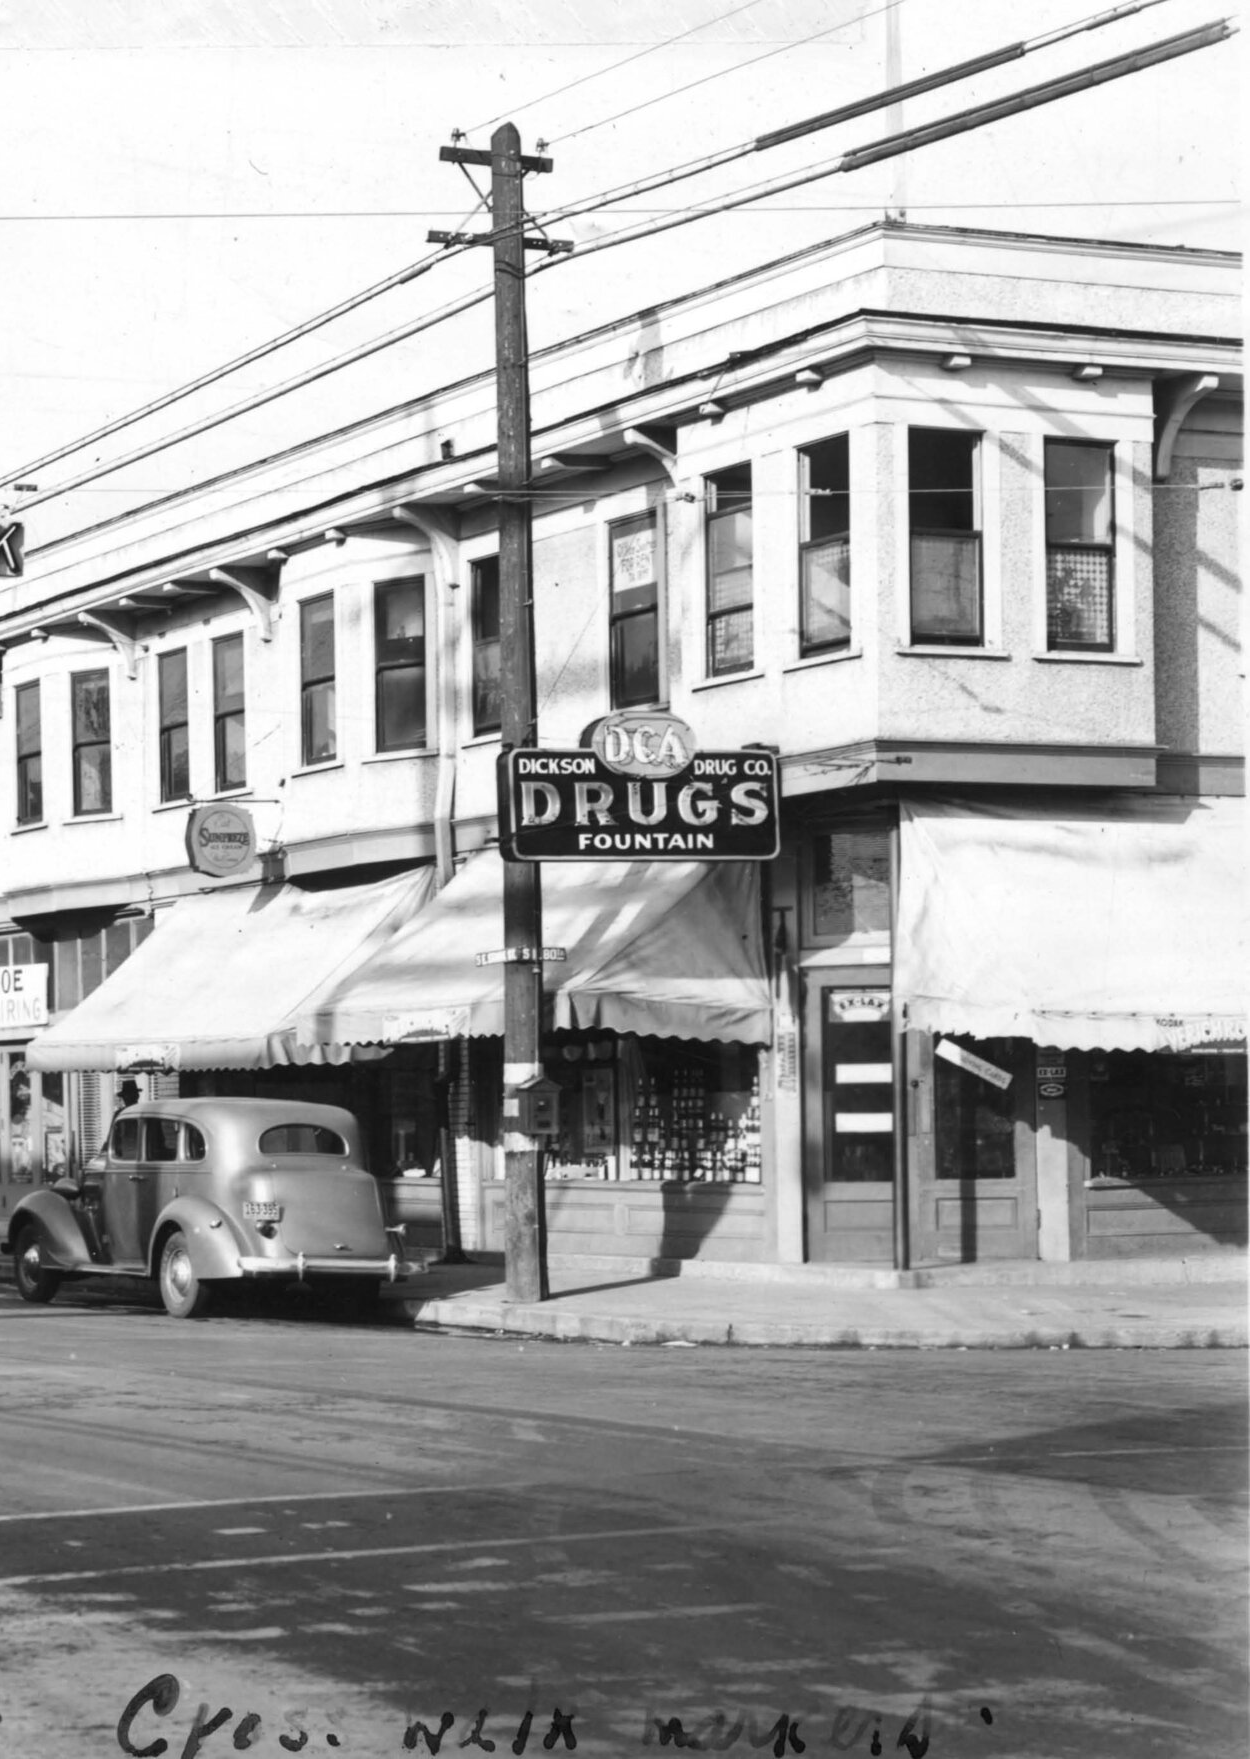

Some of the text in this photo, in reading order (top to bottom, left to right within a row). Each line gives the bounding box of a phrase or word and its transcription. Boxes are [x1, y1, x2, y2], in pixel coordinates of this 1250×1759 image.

[605, 725, 687, 768] DCA
[518, 758, 772, 775] DICKSON DRUG CO.
[520, 781, 769, 826] DRUGS
[578, 833, 714, 850] FOUNTAIN
